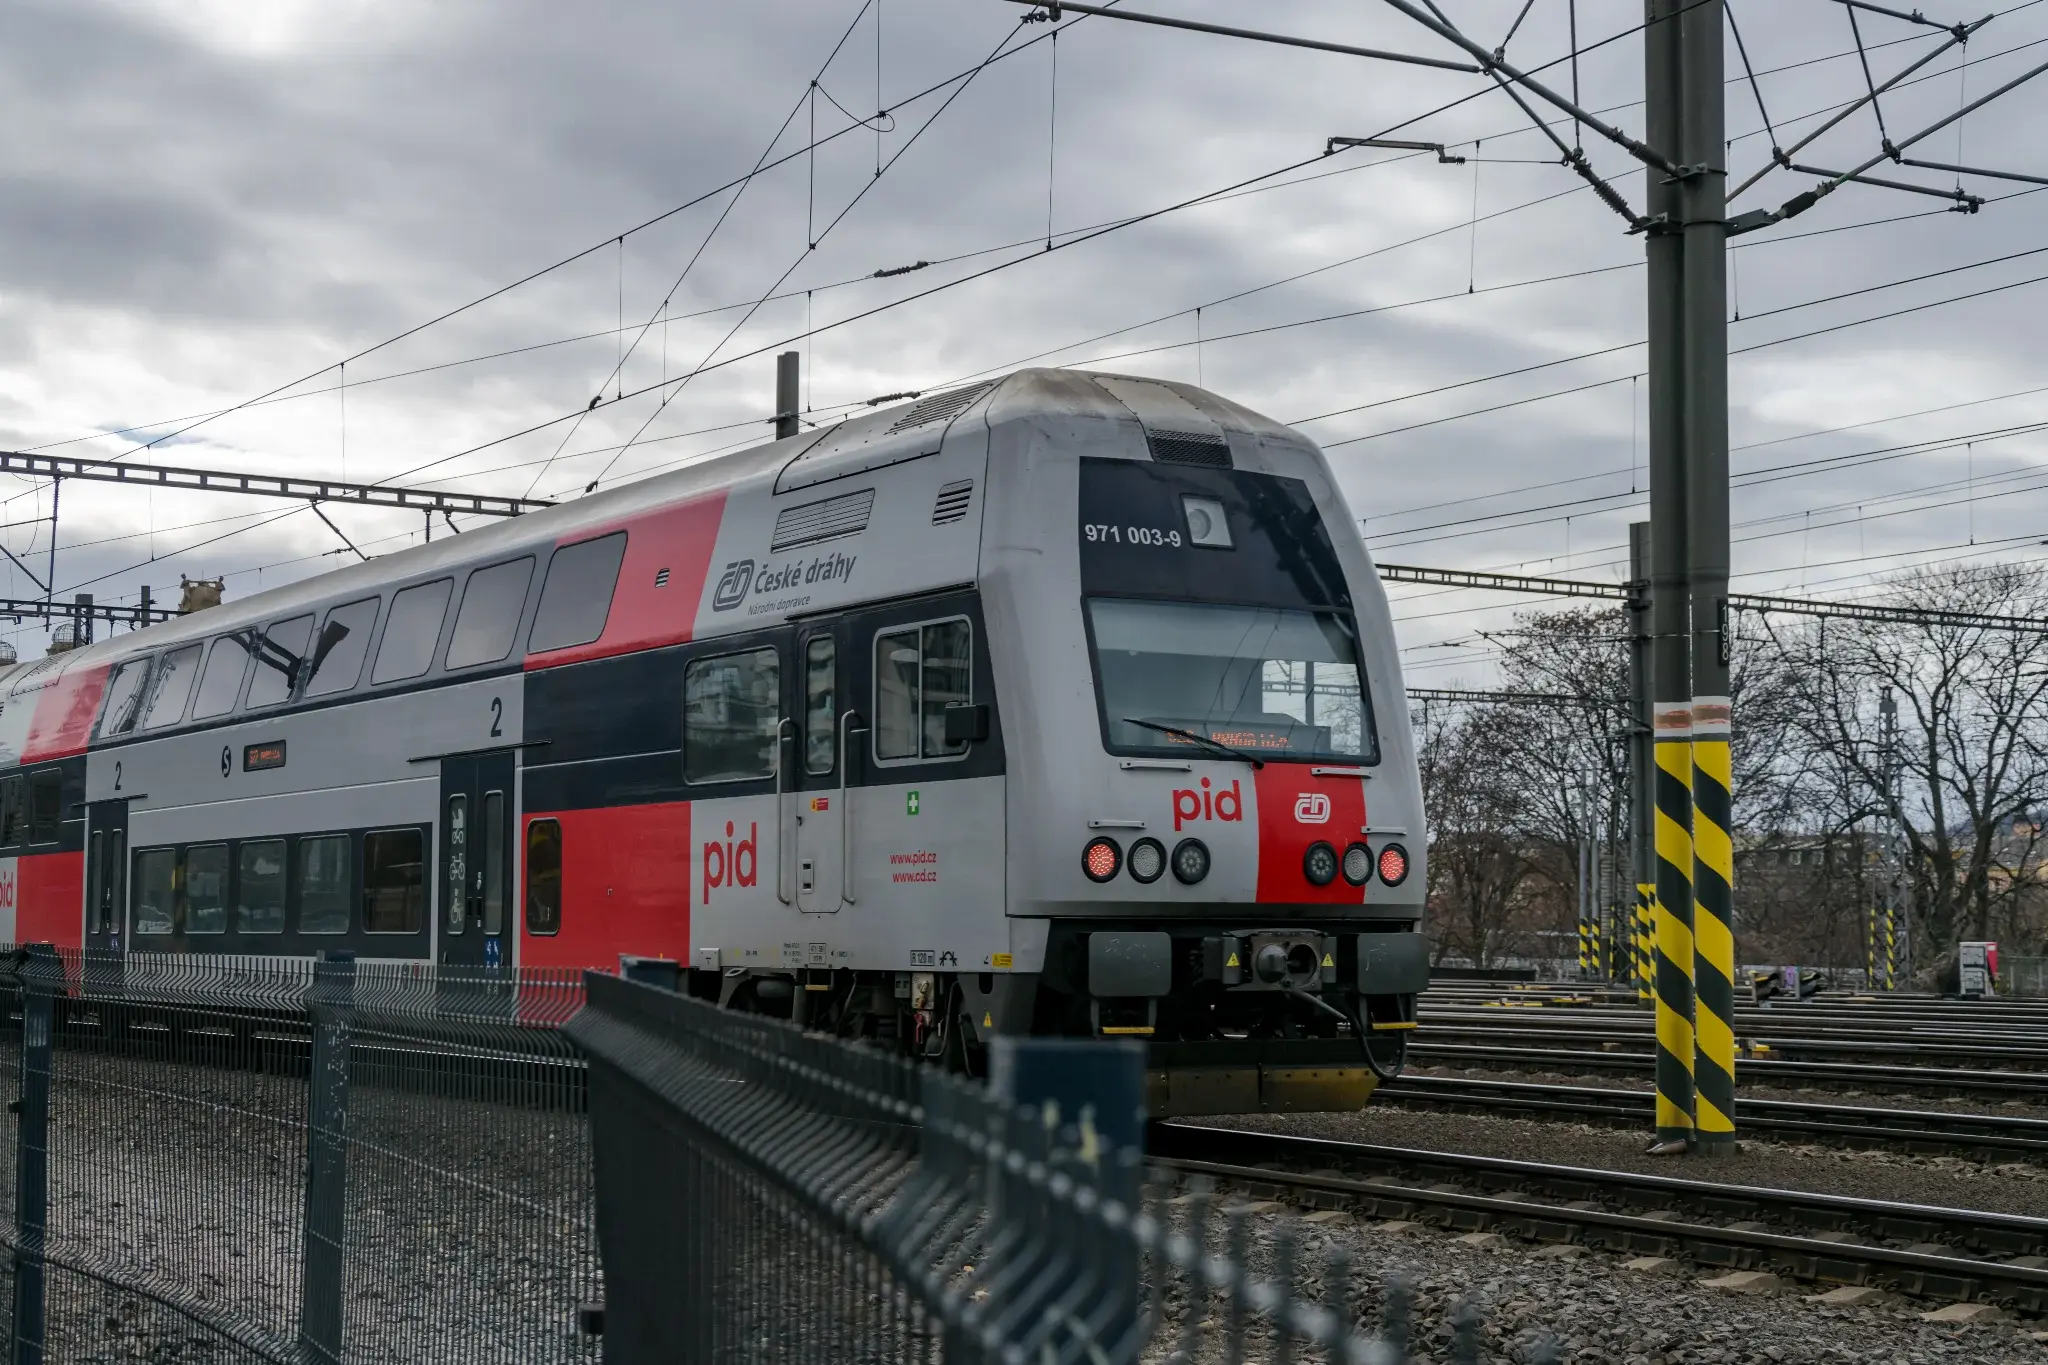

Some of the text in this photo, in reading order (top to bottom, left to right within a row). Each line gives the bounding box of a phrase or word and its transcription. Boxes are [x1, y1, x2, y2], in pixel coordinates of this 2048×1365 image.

[1085, 524, 1182, 547] 971 003-9
[754, 559, 804, 595] České
[804, 552, 858, 584] dráhy
[747, 595, 811, 616] Národní dopravce
[490, 696, 502, 738] 2
[114, 760, 122, 791] 2
[1172, 776, 1243, 832] pid
[703, 820, 757, 905] pid
[889, 849, 937, 868] www.pid.cz
[892, 869, 937, 883] www.cd.cz
